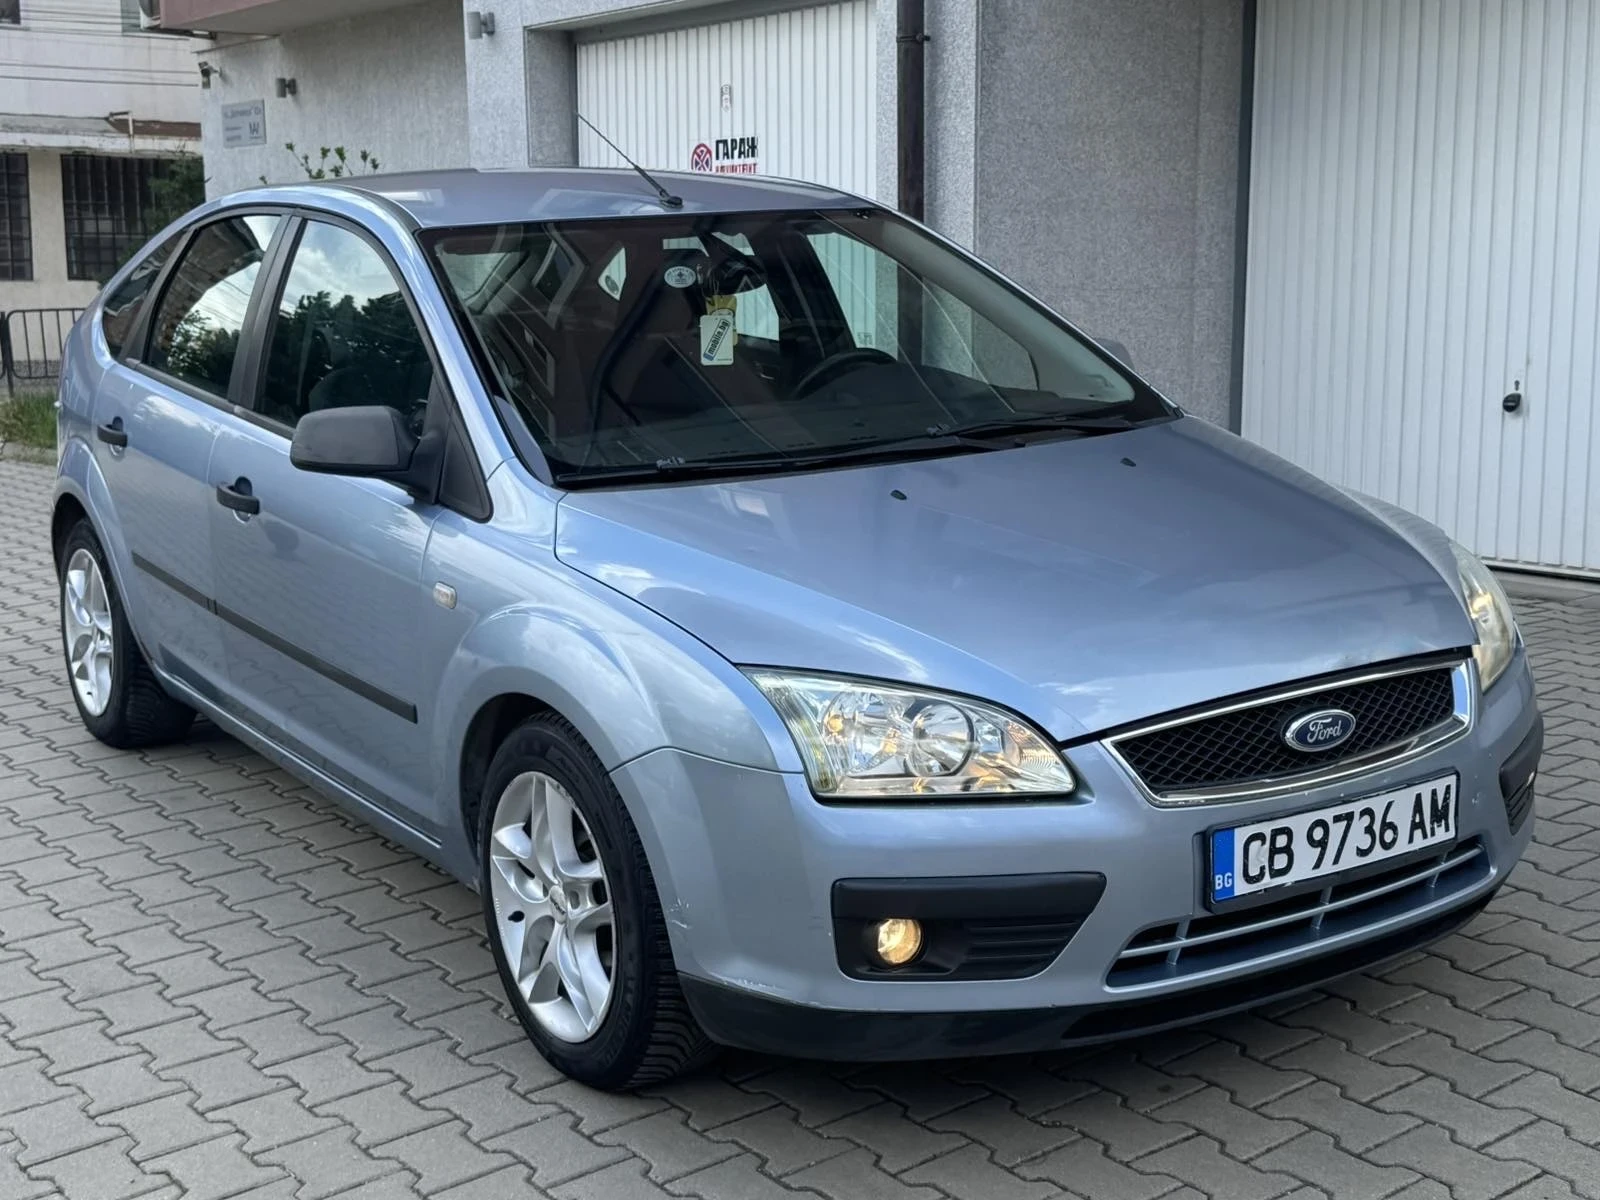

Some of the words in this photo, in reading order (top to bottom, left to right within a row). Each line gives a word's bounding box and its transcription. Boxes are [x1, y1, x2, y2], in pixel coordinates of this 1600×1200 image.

[716, 136, 758, 161] ГАРАЖ
[1308, 718, 1342, 743] Ford
[1243, 826, 1295, 885] CB
[1306, 801, 1399, 870] 9736
[1408, 784, 1452, 845] AM
[1215, 872, 1233, 891] BG
